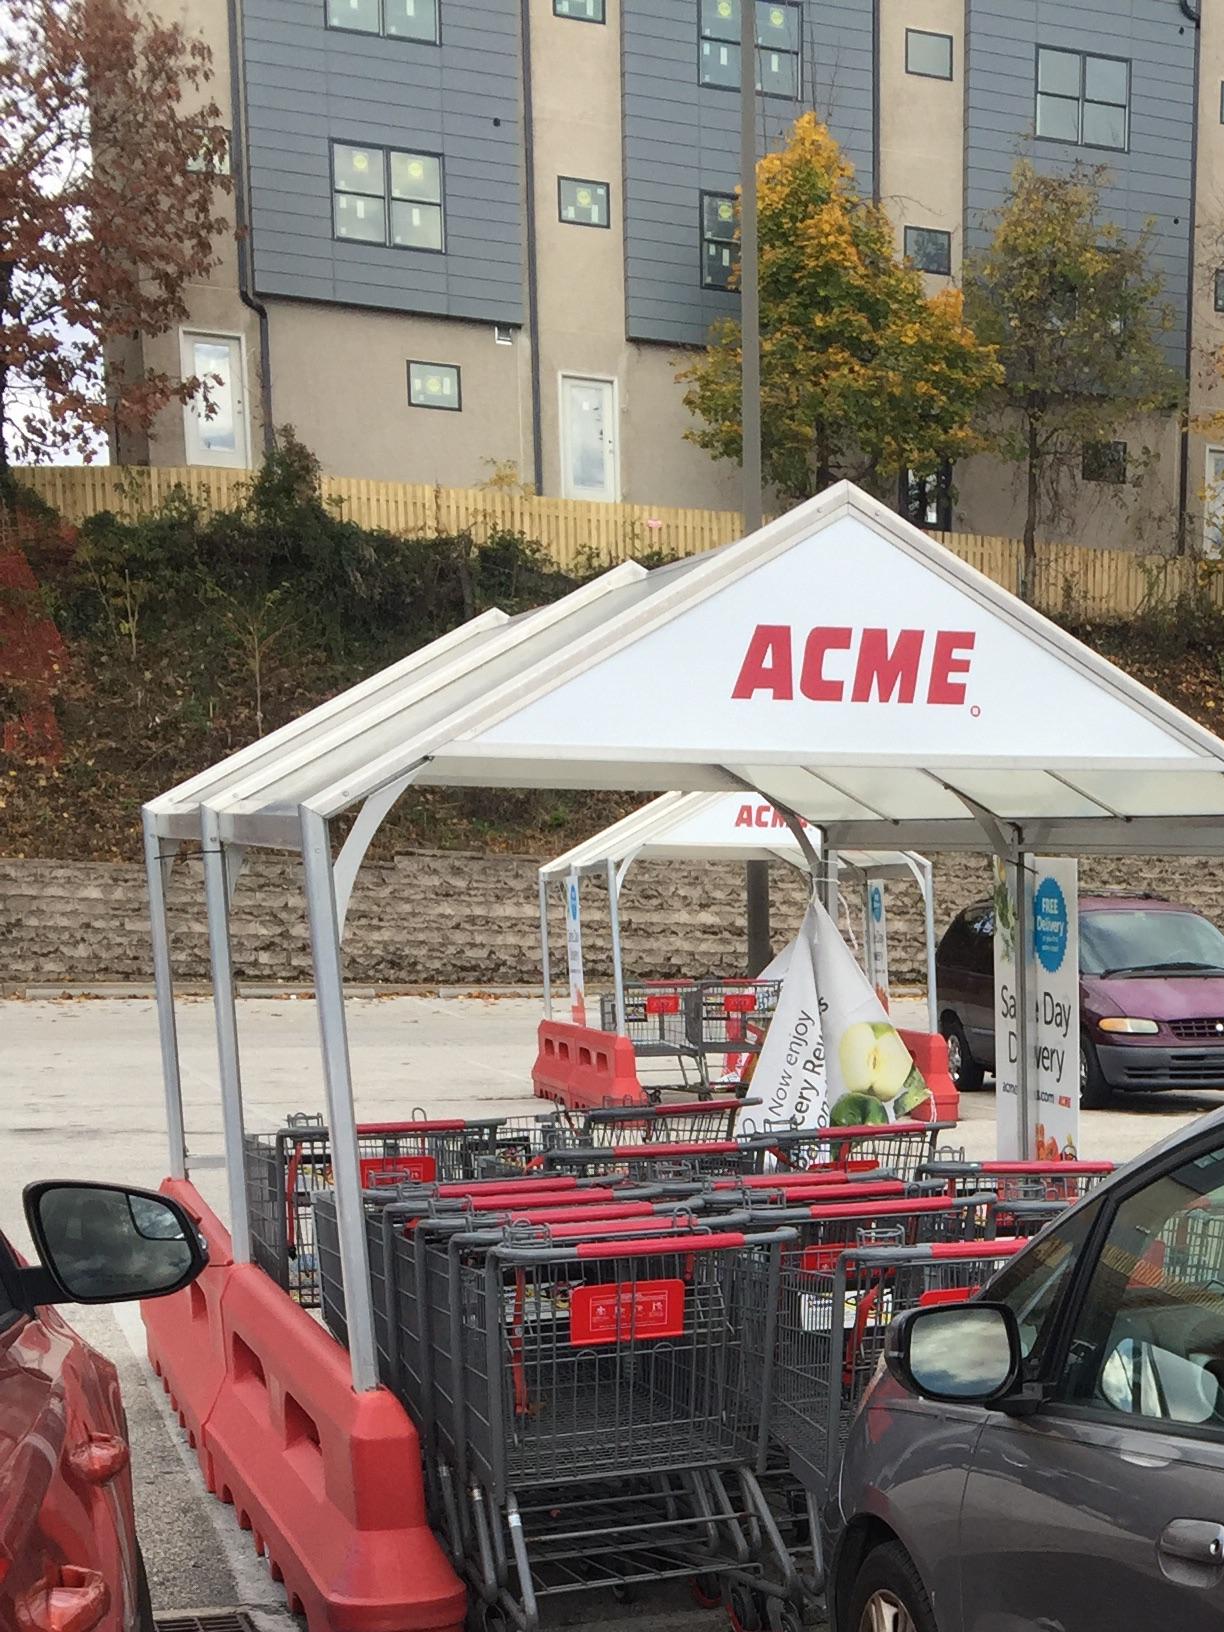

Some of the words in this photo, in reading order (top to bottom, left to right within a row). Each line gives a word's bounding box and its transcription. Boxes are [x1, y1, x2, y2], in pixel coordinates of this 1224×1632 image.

[731, 624, 976, 704] ACME
[735, 805, 808, 828] ACM
[1041, 897, 1059, 915] FREE
[1036, 915, 1065, 937] Delivery
[1043, 991, 1071, 1038] Day
[768, 1069, 793, 1117] Now
[786, 1009, 816, 1067] enjoy
